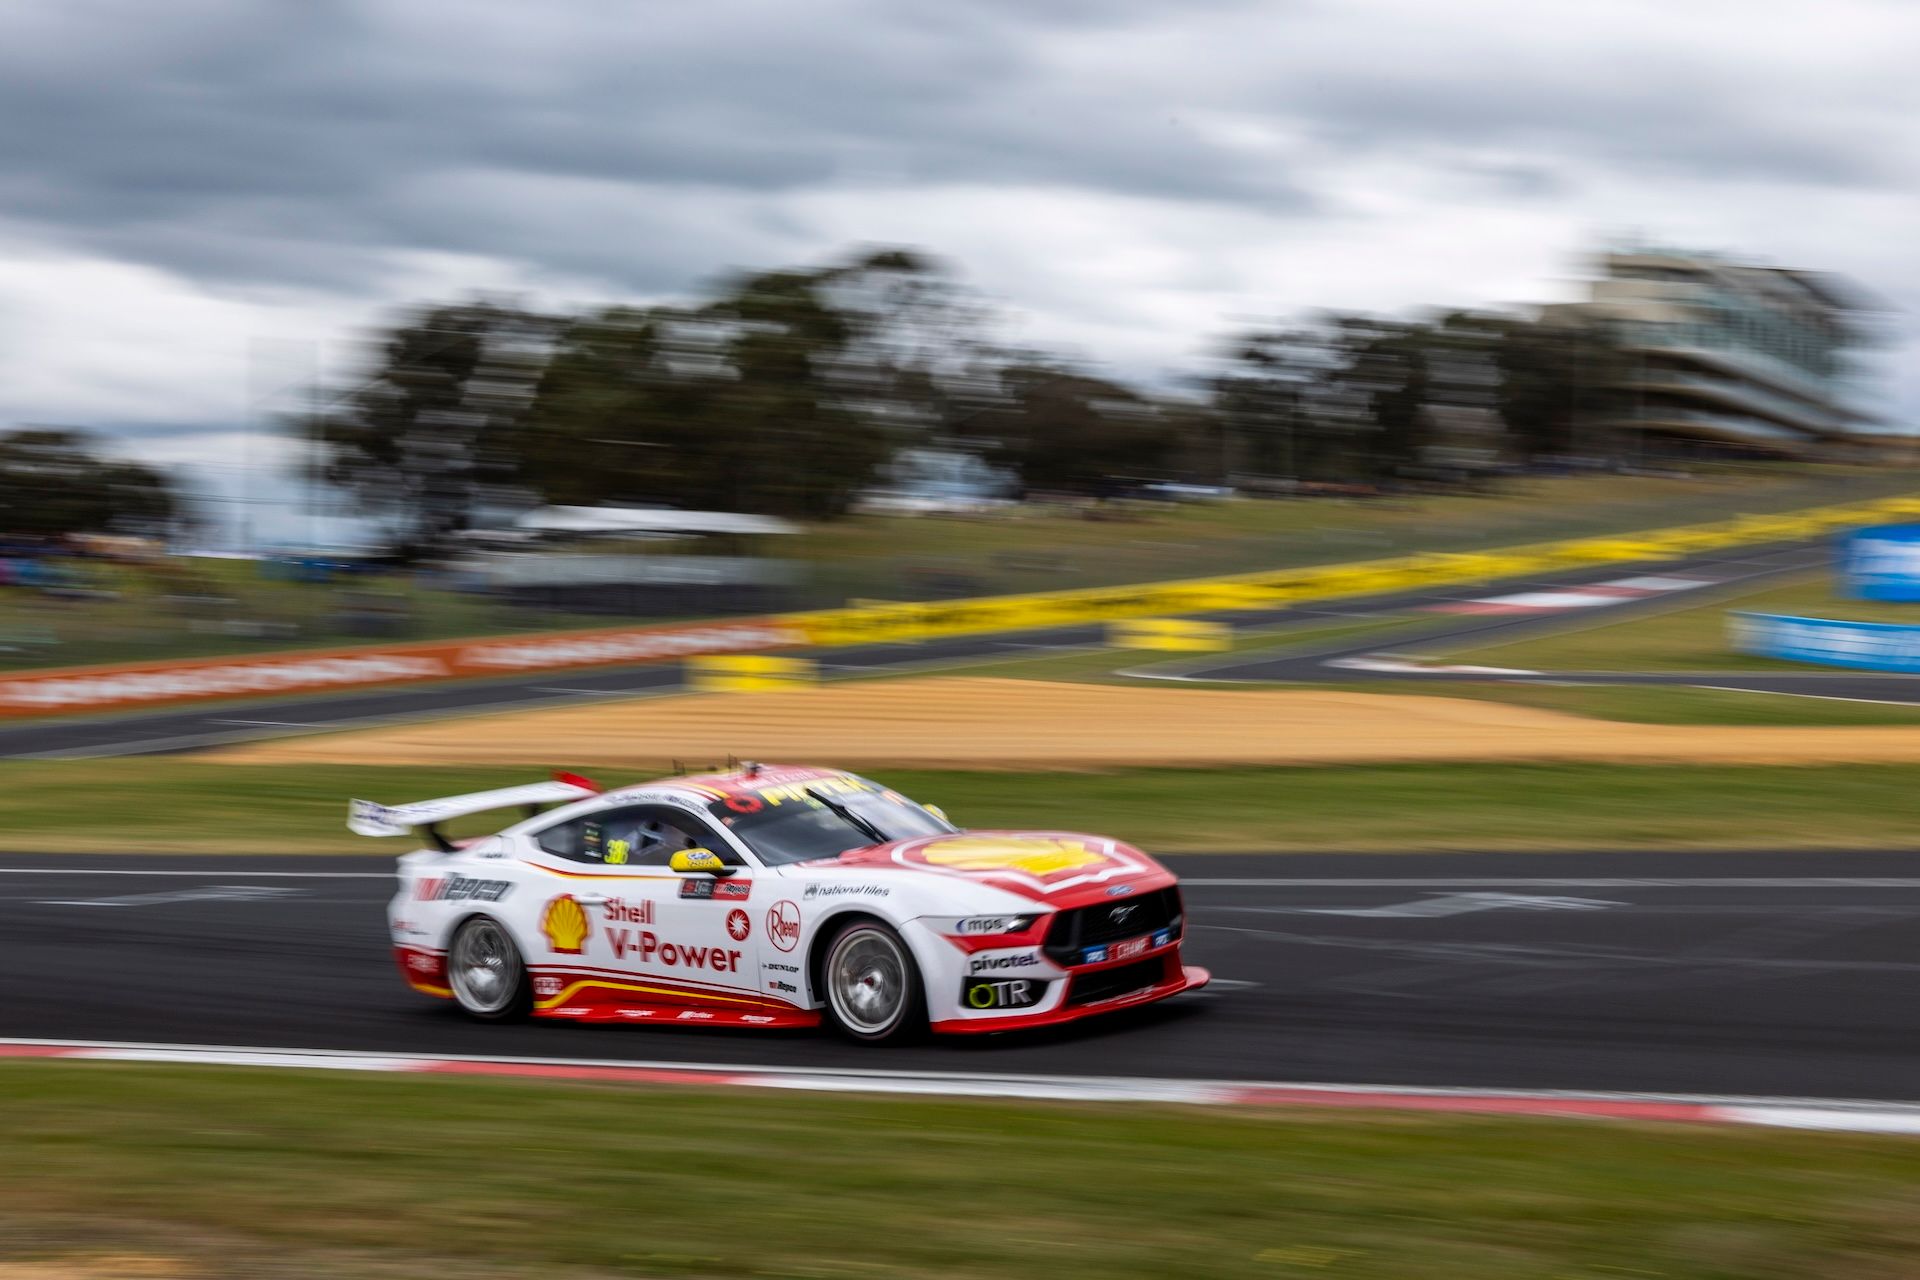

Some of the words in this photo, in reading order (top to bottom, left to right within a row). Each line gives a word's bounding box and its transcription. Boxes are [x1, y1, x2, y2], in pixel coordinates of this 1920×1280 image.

[819, 883, 866, 896] national
[865, 885, 890, 897] tiles
[603, 897, 655, 924] Shell
[771, 901, 799, 943] Rheem
[968, 919, 1003, 933] mps
[604, 926, 742, 973] V-Power
[768, 963, 799, 973] DUNLOP
[968, 980, 1032, 1008] OTR
